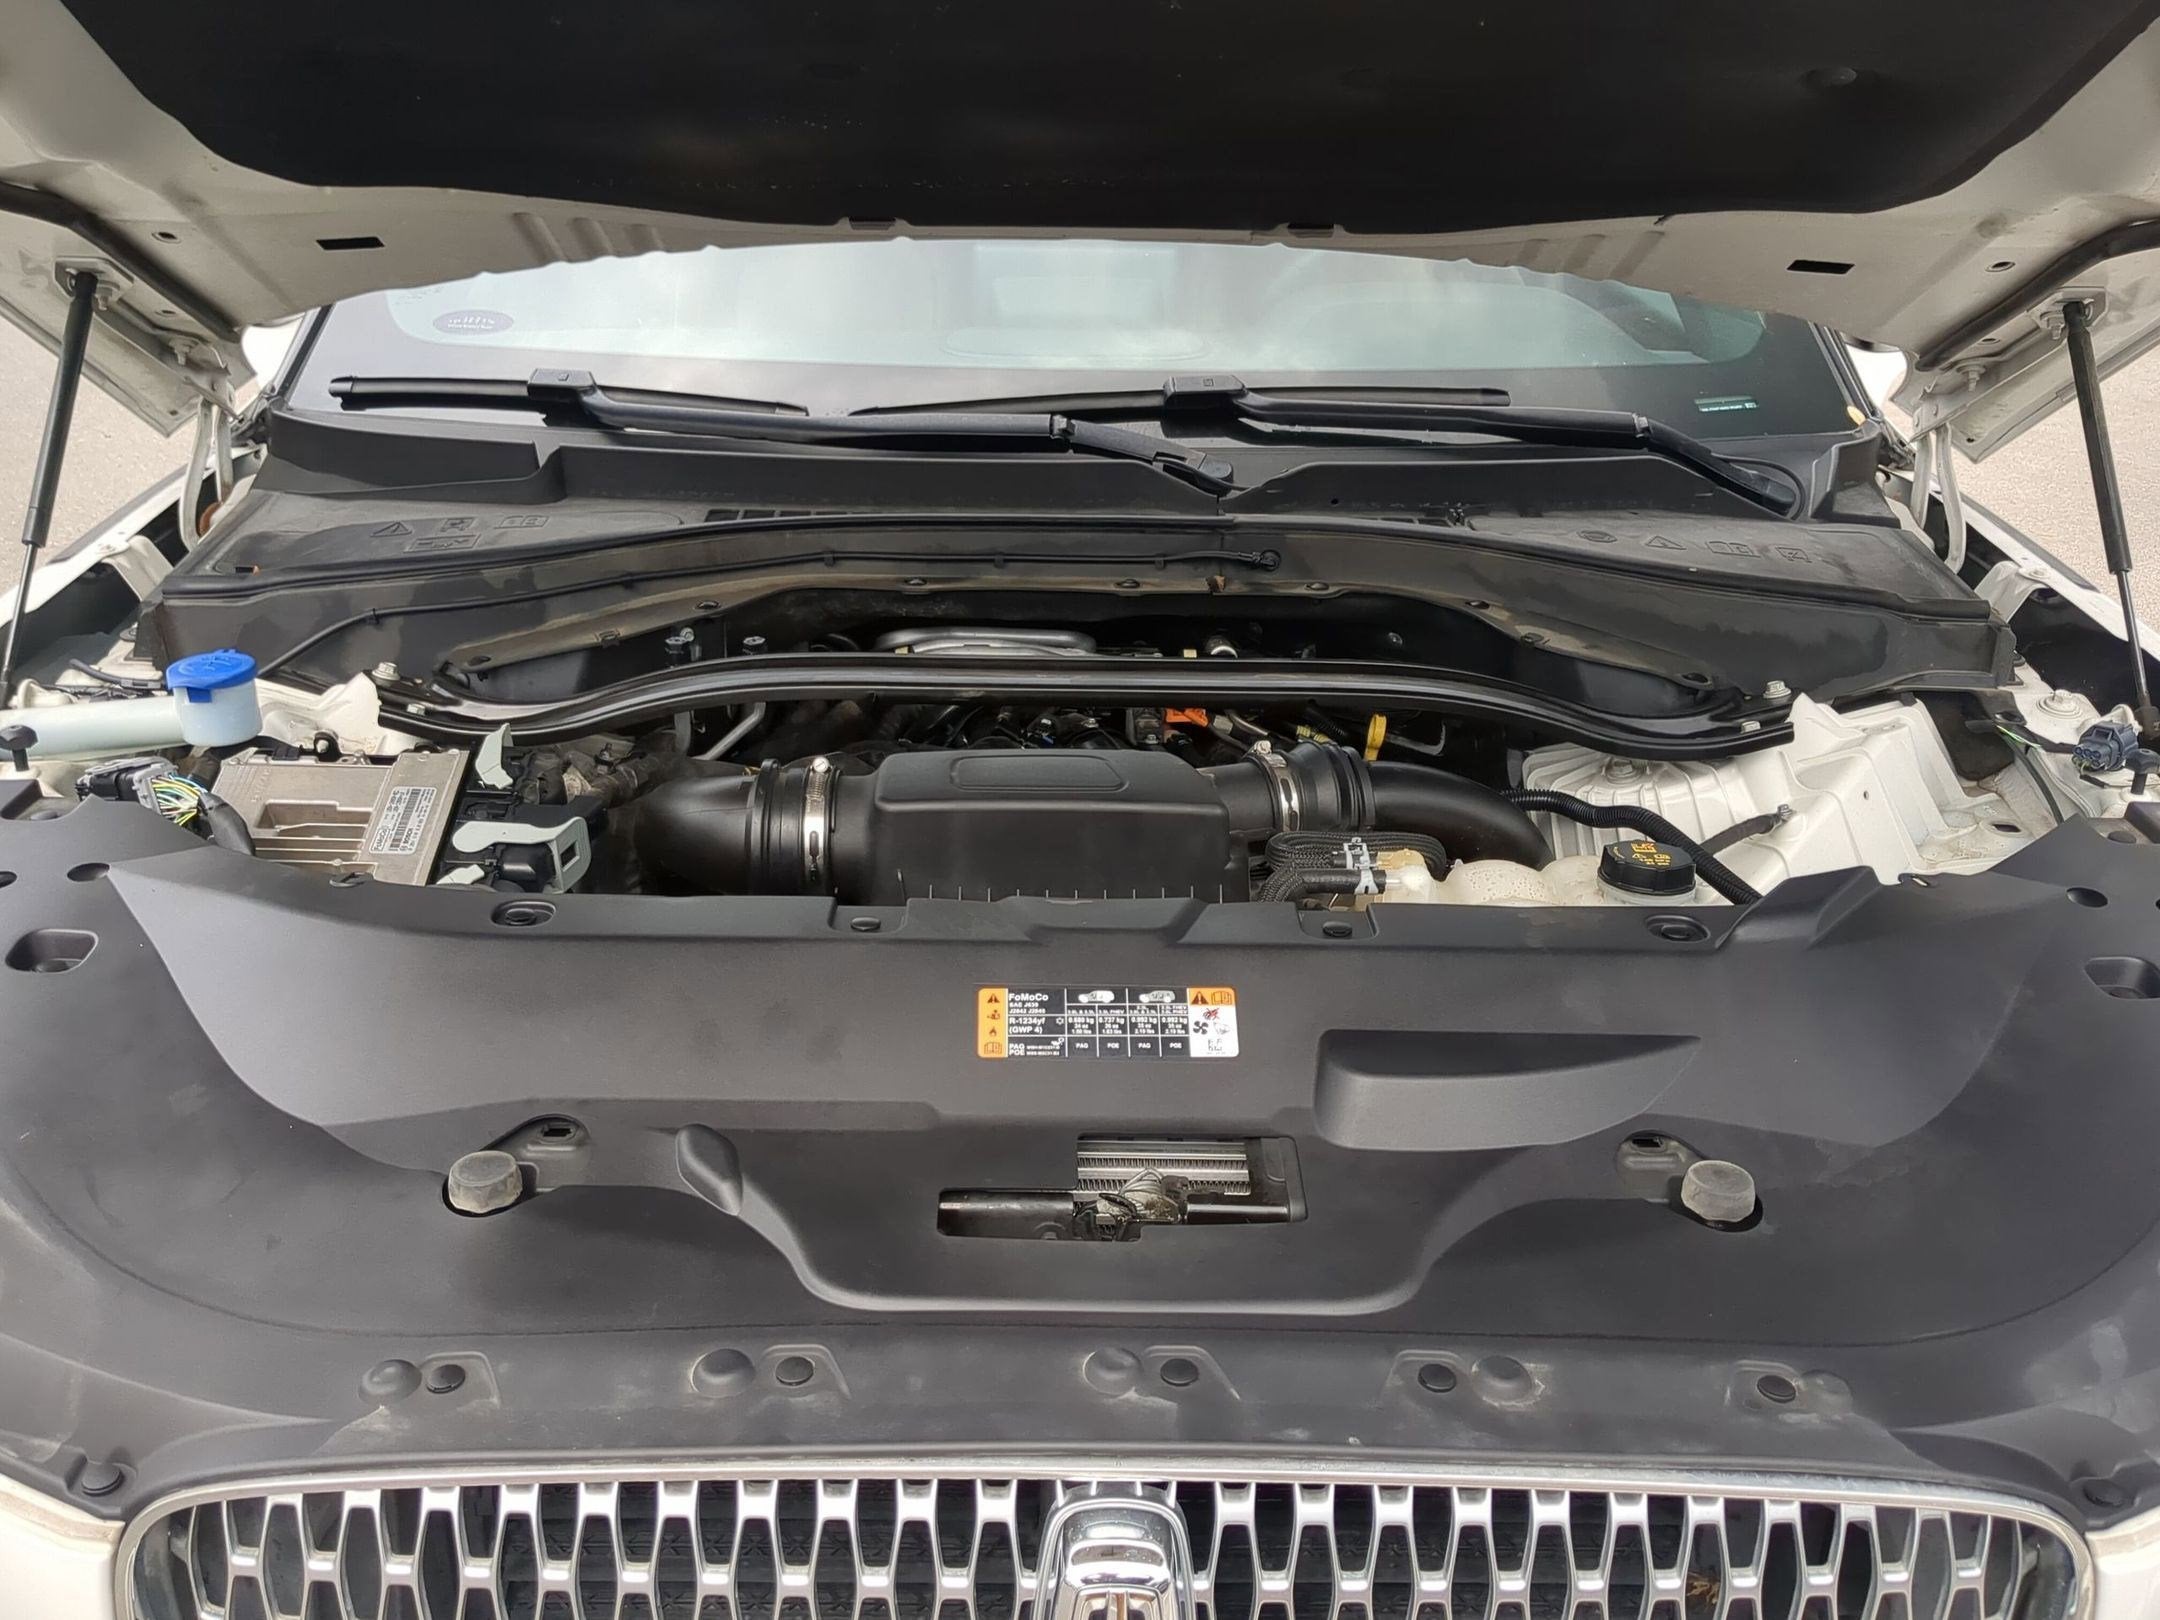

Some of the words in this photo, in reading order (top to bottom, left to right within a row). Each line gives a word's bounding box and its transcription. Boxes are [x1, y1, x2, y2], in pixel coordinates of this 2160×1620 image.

[1009, 993, 1049, 1001] FoMoCo
[1009, 1017, 1046, 1026] R-1234yf
[1009, 1026, 1033, 1034] (GWP
[1034, 1026, 1043, 1034] 4)
